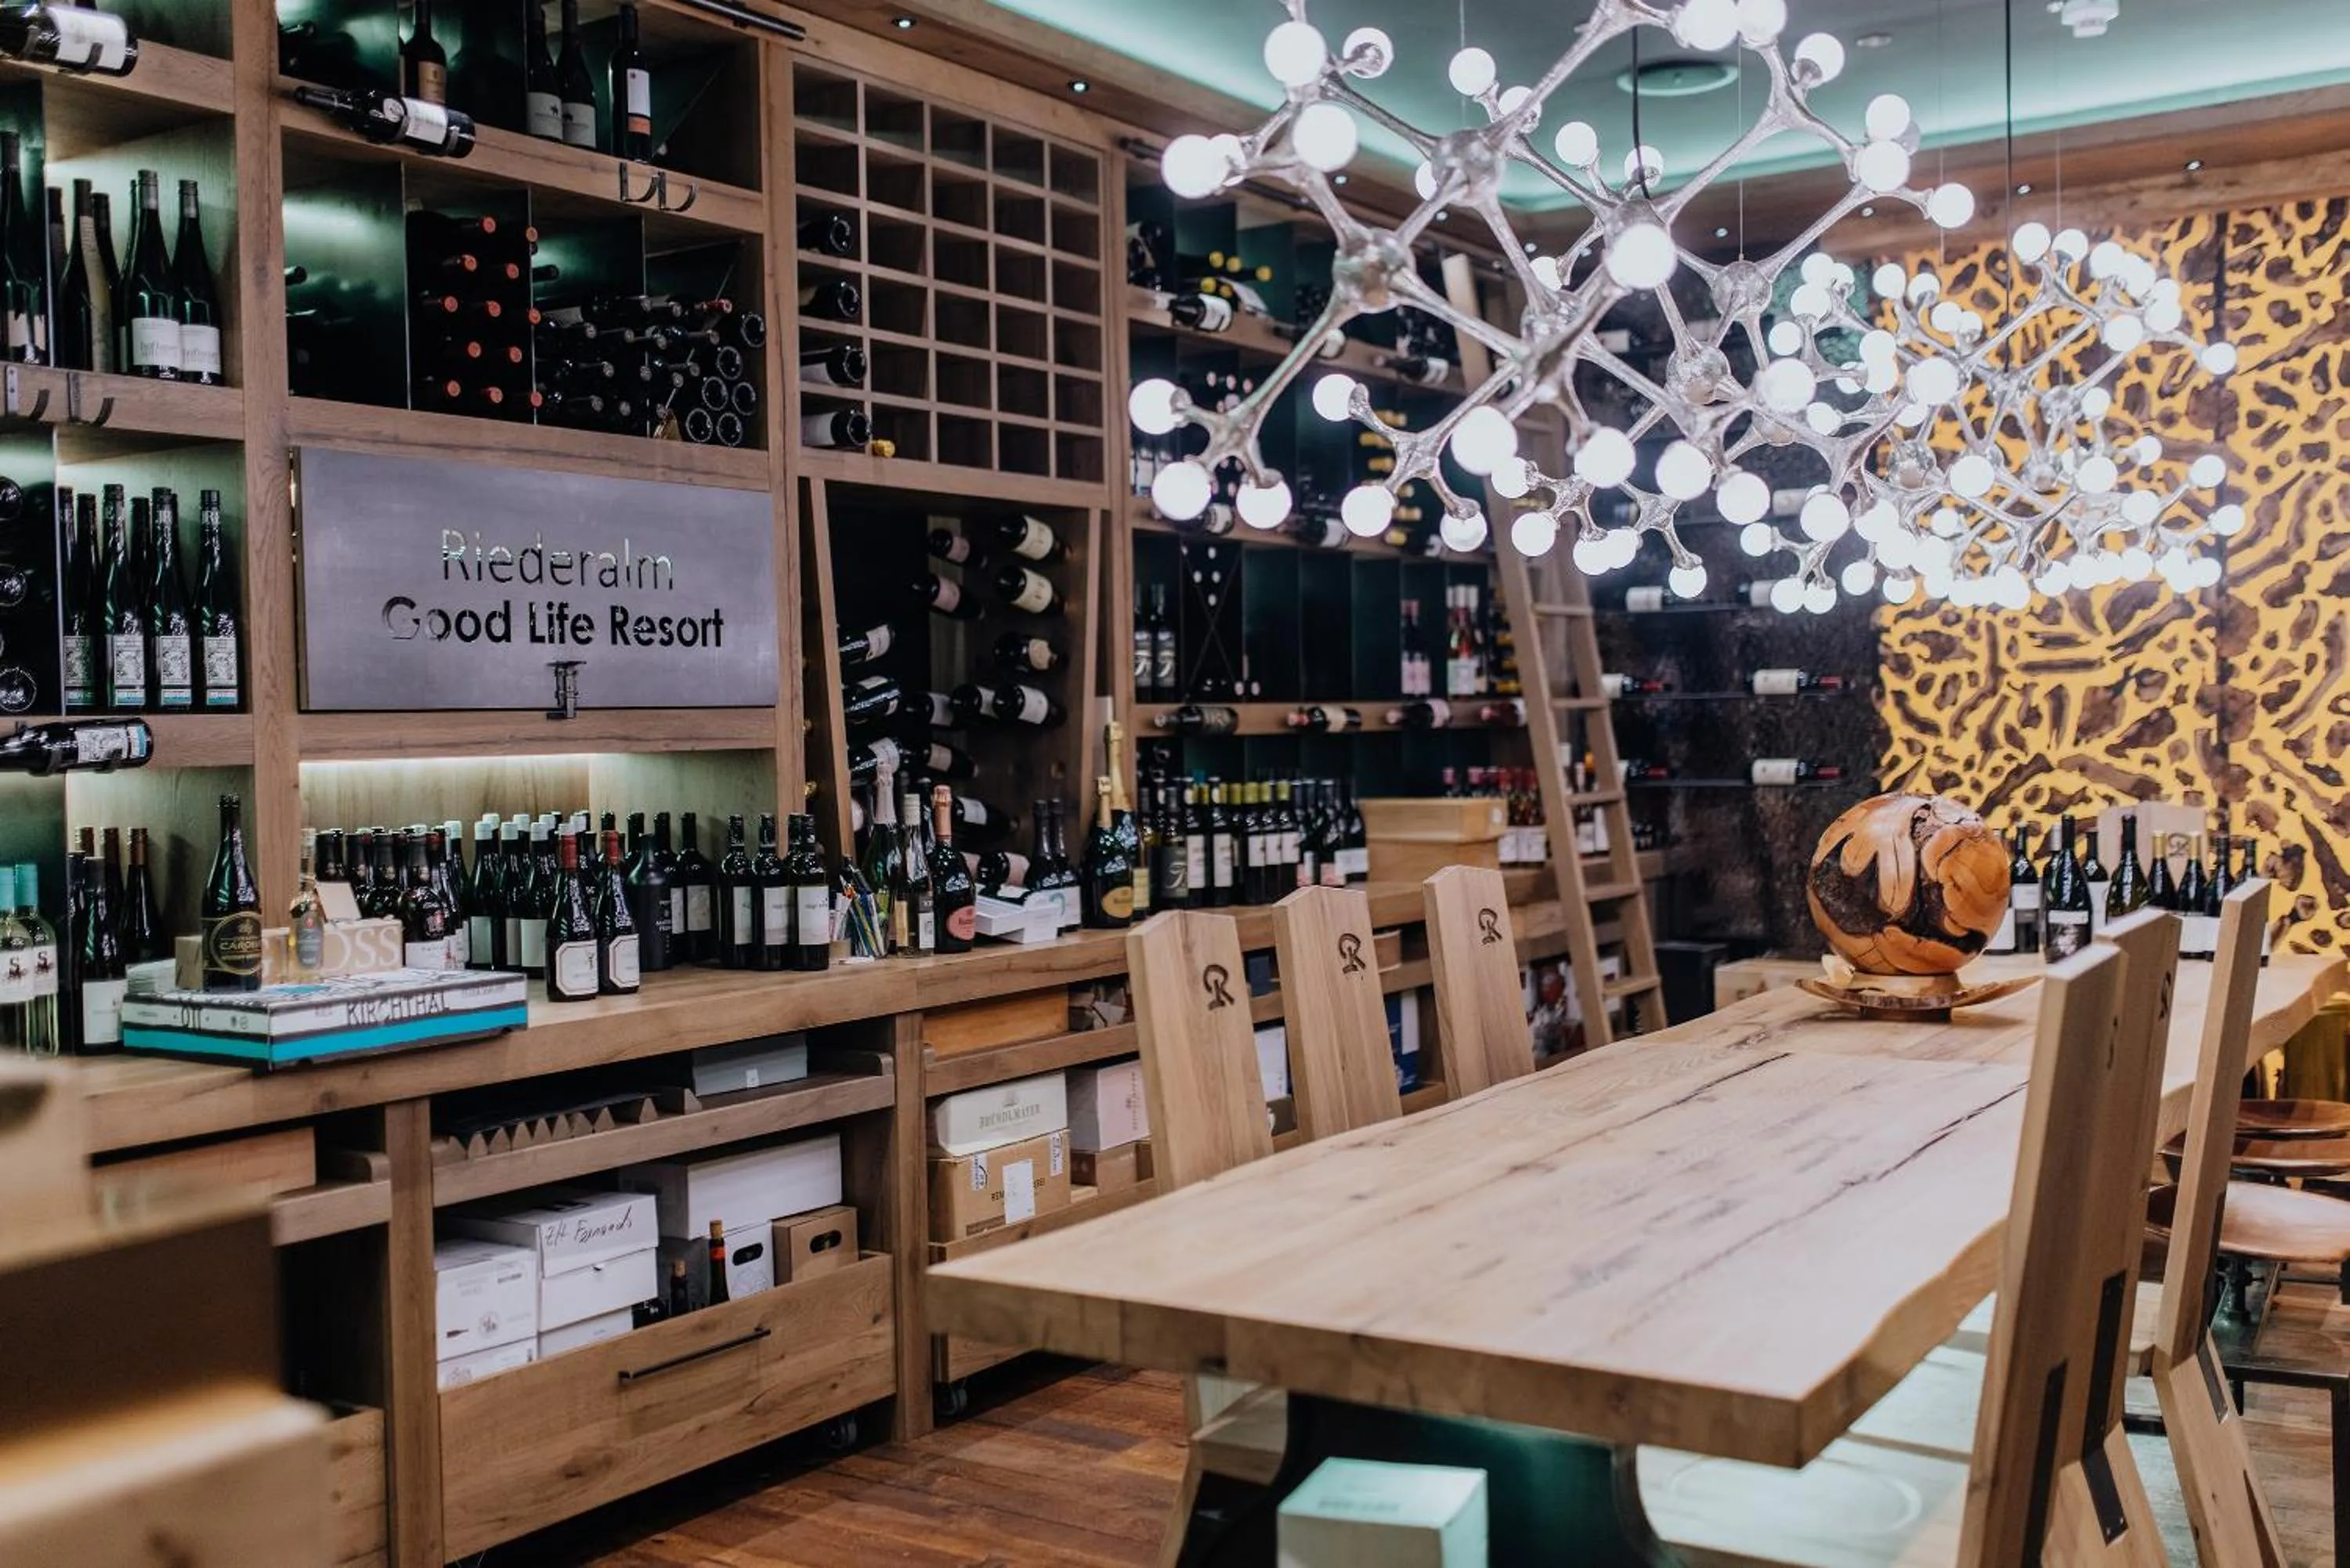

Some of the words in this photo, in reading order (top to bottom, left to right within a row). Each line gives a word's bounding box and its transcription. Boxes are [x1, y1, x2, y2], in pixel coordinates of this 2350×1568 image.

[441, 528, 674, 591] Riederalm
[381, 595, 512, 643] Good
[529, 601, 595, 645] Life
[609, 604, 725, 649] Resort
